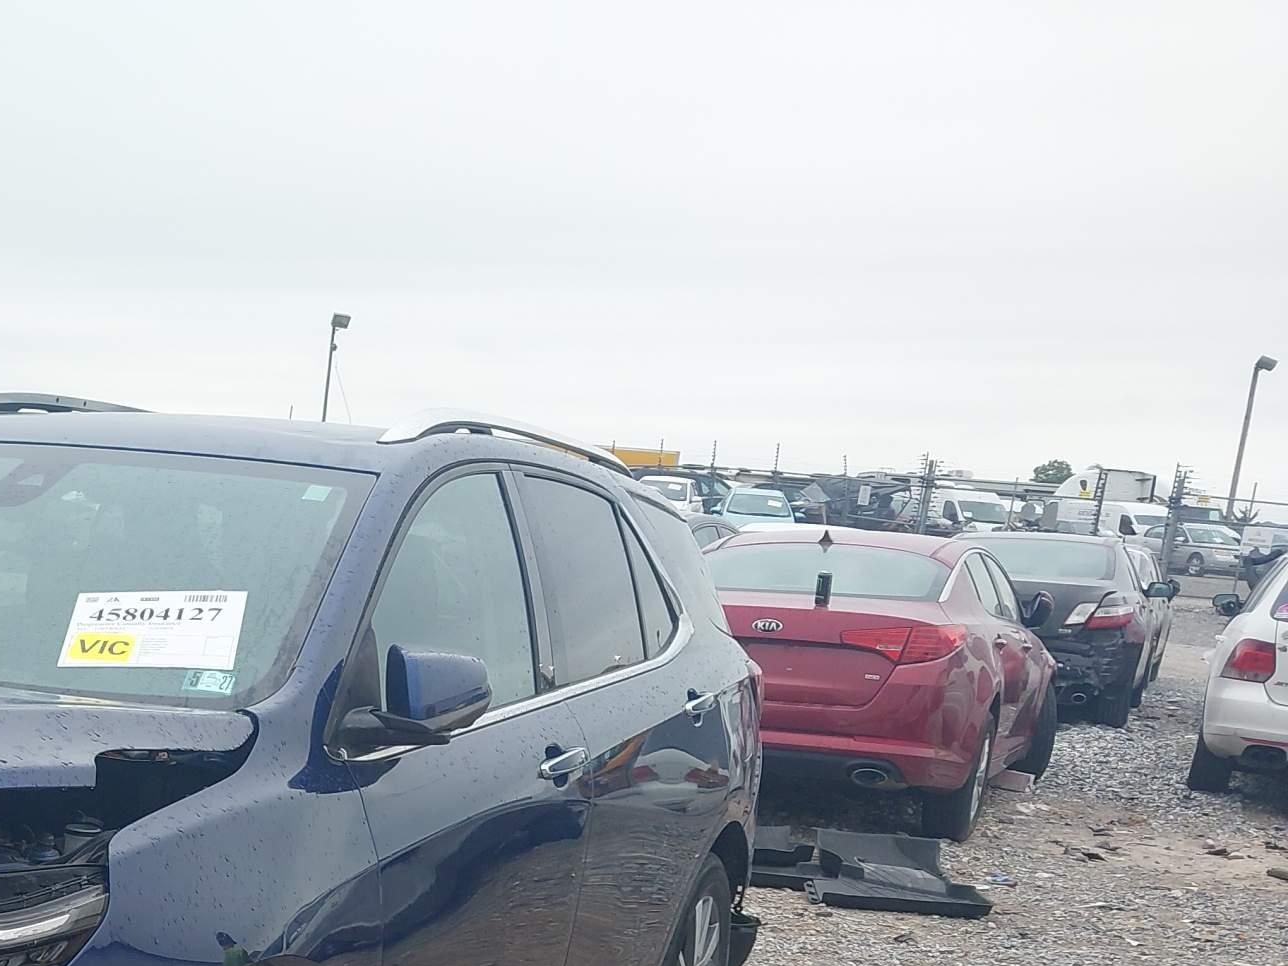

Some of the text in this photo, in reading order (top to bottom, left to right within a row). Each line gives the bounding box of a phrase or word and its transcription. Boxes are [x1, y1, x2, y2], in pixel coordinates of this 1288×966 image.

[89, 607, 222, 621] 45804127
[78, 639, 130, 655] VIC
[219, 675, 233, 691] 27
